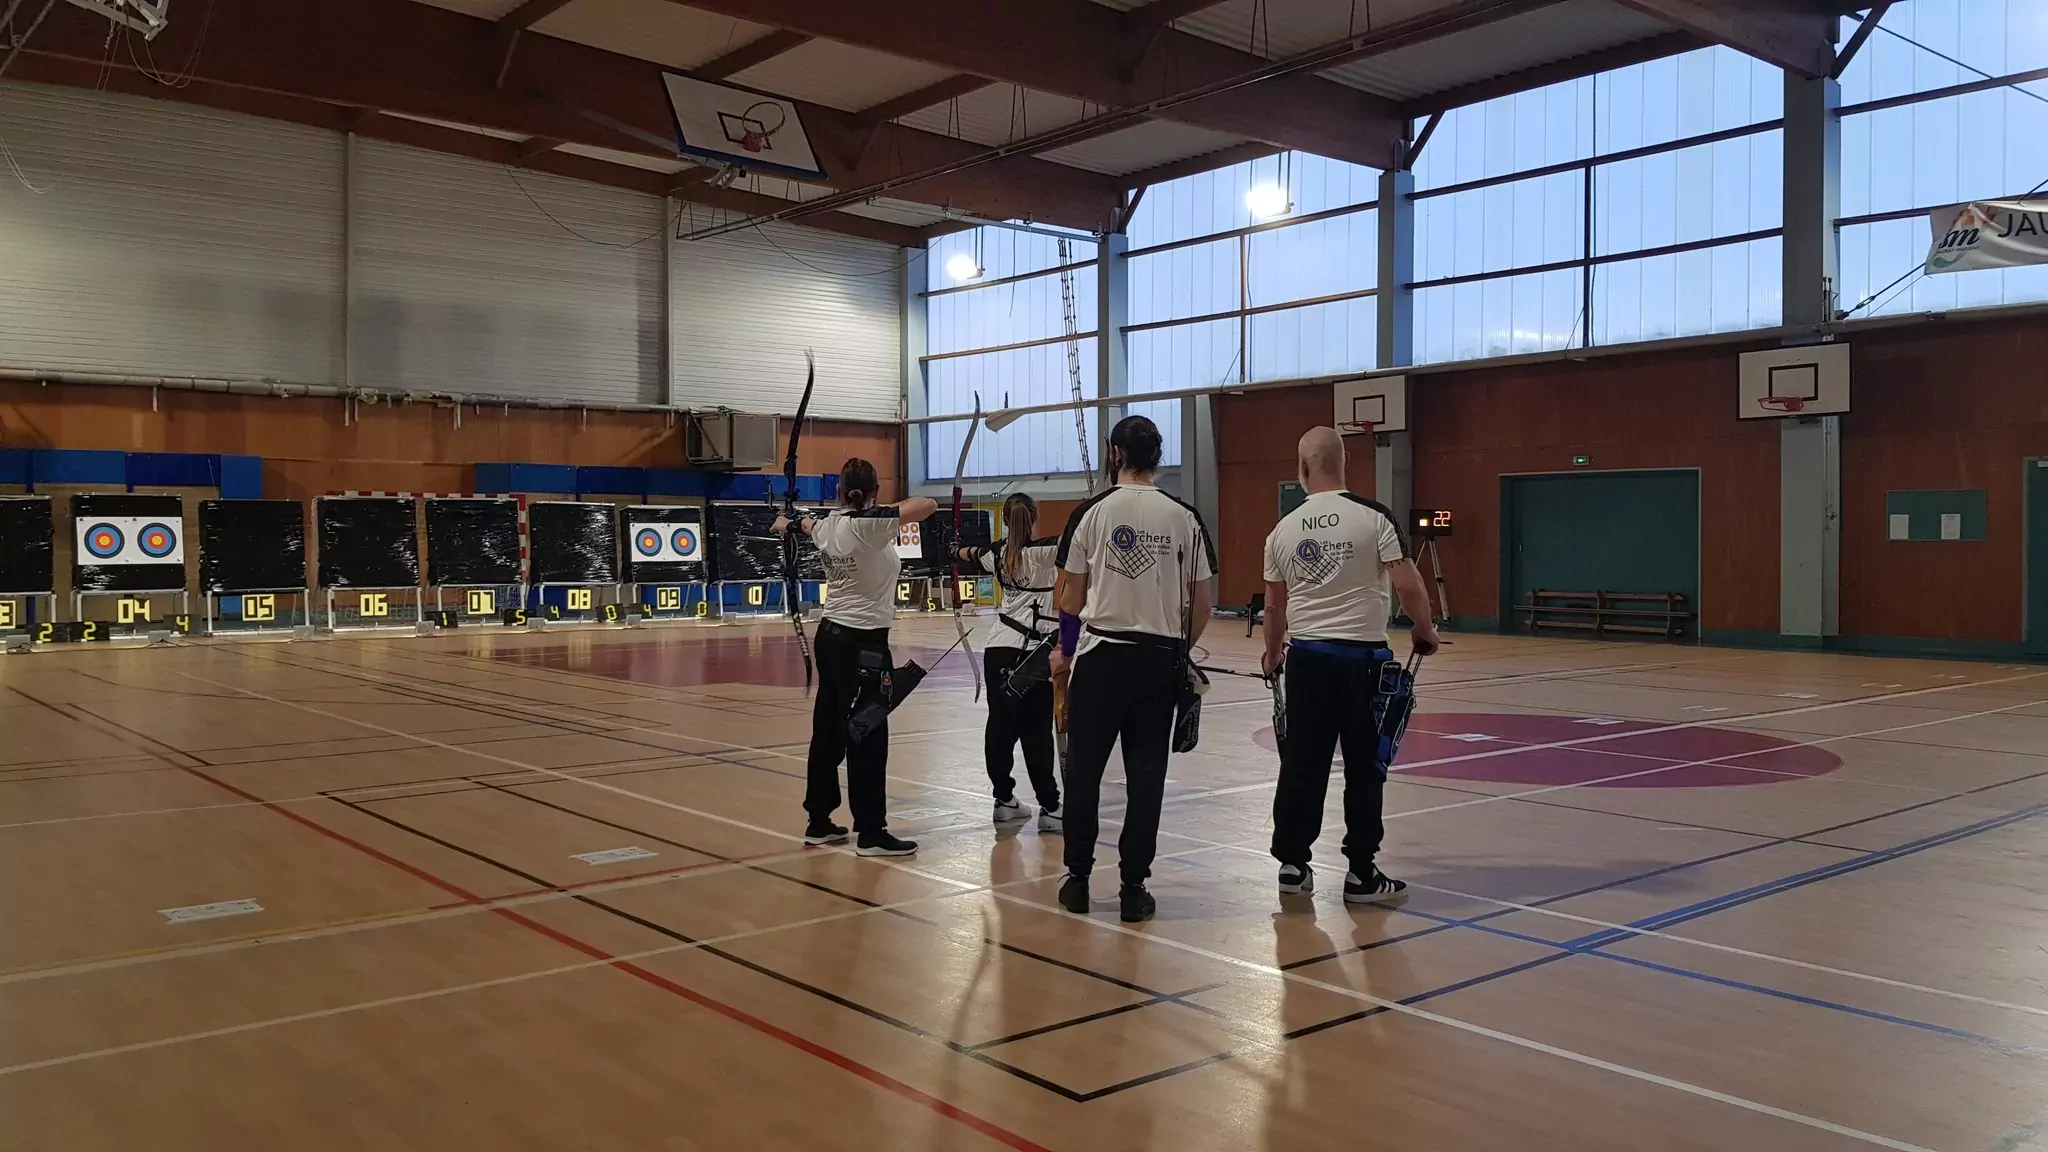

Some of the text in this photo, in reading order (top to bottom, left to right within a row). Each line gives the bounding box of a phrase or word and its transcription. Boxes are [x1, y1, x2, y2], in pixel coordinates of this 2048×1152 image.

[1302, 513, 1340, 531] NICO
[1433, 511, 1451, 527] 22
[360, 594, 388, 616] 06
[567, 589, 592, 610] 08
[658, 588, 679, 608] 09
[926, 597, 936, 611] 6
[117, 599, 151, 624] 04
[243, 595, 273, 619] 05
[550, 605, 560, 619] 4
[605, 604, 618, 620] 0
[643, 603, 653, 617] 4
[697, 601, 707, 617] 0
[175, 615, 189, 632] 4
[515, 609, 526, 624] 5
[39, 622, 54, 642] 2
[83, 621, 97, 640] 2
